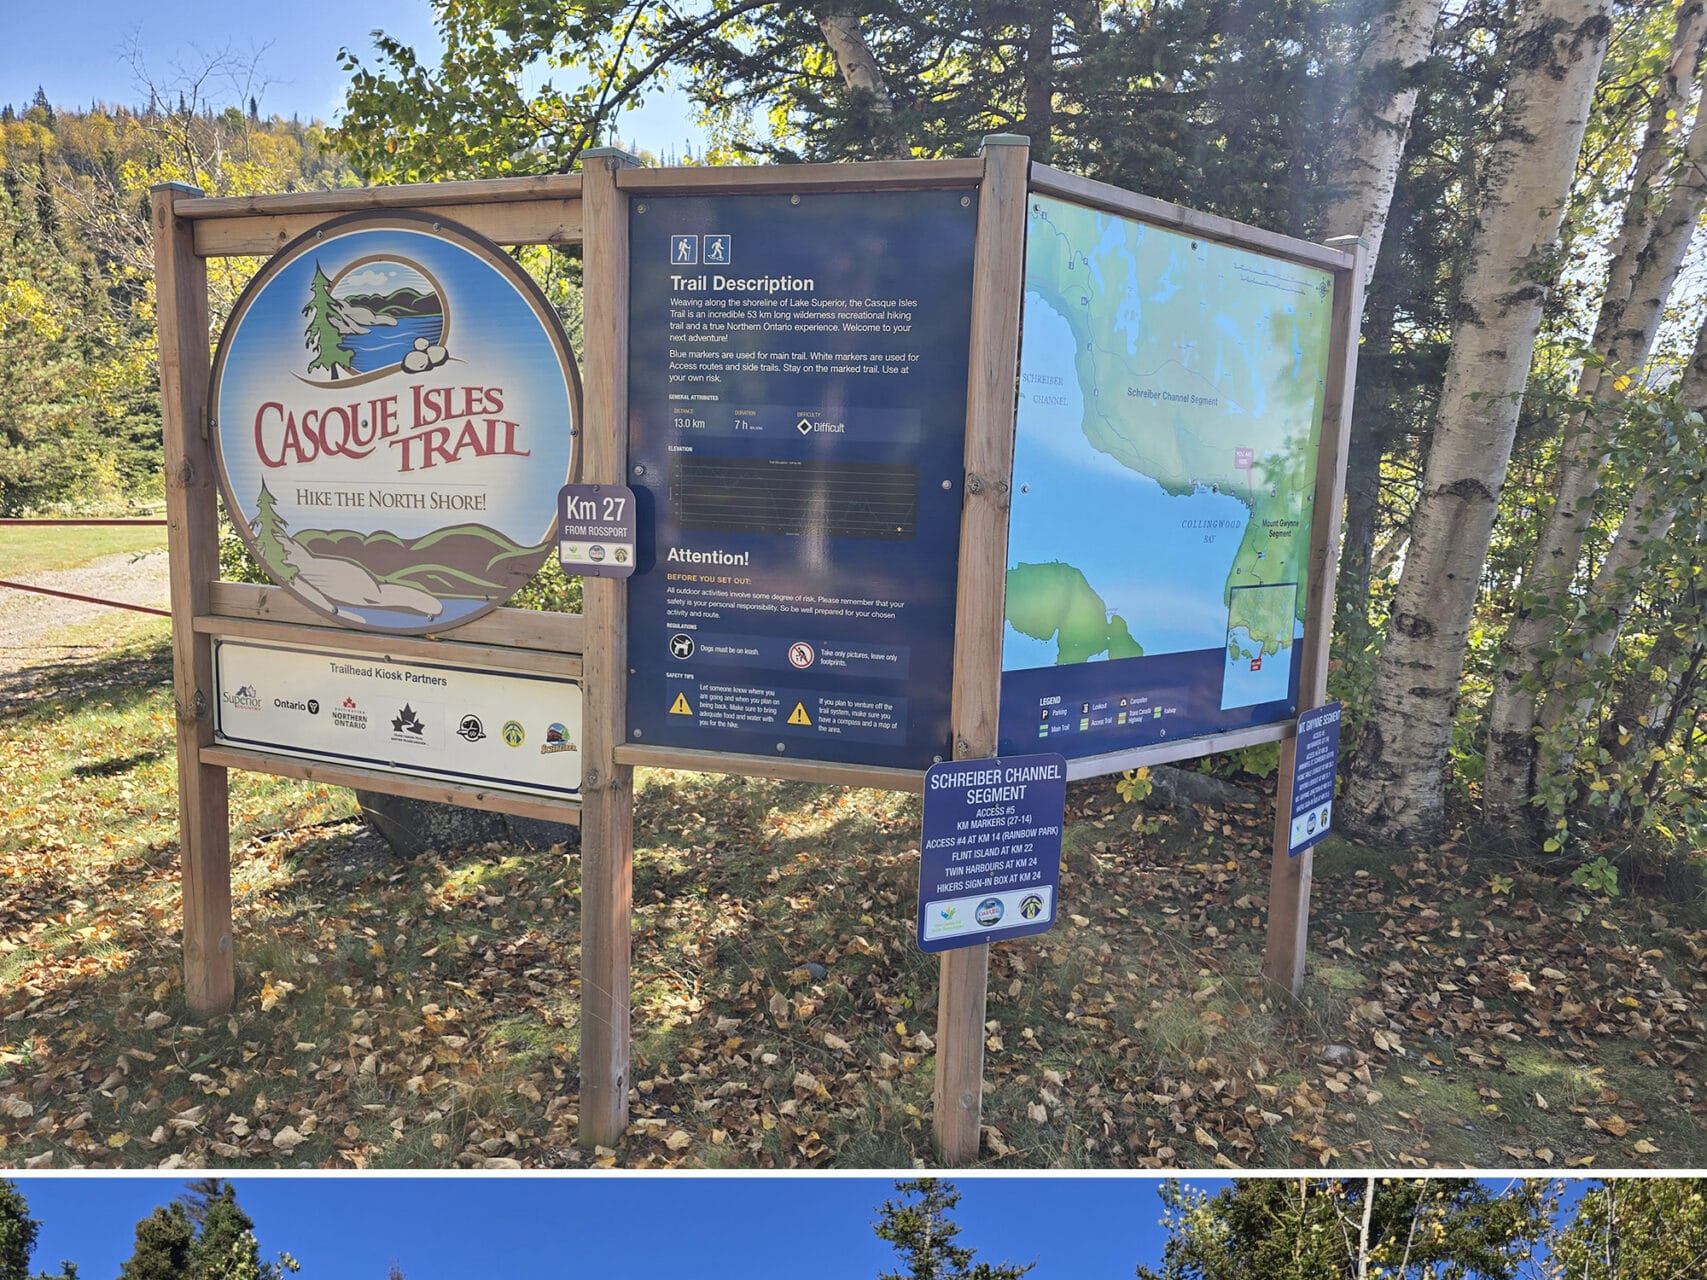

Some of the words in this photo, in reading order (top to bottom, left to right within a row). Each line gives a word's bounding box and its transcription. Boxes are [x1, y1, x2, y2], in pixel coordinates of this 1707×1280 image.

[671, 275, 706, 290] Trail
[713, 275, 814, 294] Description
[670, 298, 702, 308] Weaving
[705, 298, 726, 308] along
[728, 298, 740, 306] the
[743, 298, 777, 306] shoreline
[780, 298, 788, 307] of
[790, 299, 809, 307] Lake
[812, 298, 847, 308] Superior,
[850, 299, 862, 307] the
[865, 299, 896, 308] Casque
[899, 299, 917, 307] Isles
[670, 310, 685, 318] Trail
[688, 310, 694, 318] is
[708, 310, 745, 318] incredible
[774, 311, 791, 320] long
[793, 311, 835, 319] wilderness
[838, 311, 884, 319] recreational
[887, 311, 911, 321] hiking
[670, 322, 684, 330] trail
[686, 322, 700, 330] and
[727, 322, 761, 330] Northern
[794, 323, 840, 333] experience.
[842, 323, 880, 331] Welcome
[893, 325, 912, 334] your
[688, 334, 728, 342] adventure!
[670, 350, 687, 358] Blue
[689, 351, 720, 359] markers
[736, 351, 755, 359] used
[757, 351, 768, 359] for
[792, 352, 808, 360] trail.
[810, 352, 833, 360] White
[885, 353, 905, 361] used
[908, 353, 920, 361] for
[1033, 395, 1068, 406] CHANNEL
[1127, 387, 1160, 401] Schreiber
[1162, 391, 1188, 404] Channel
[1190, 393, 1218, 408] Segment
[255, 394, 399, 468] CASQUE
[410, 385, 504, 429] ISLES
[674, 418, 690, 428] 13.0
[692, 419, 705, 428] km
[735, 420, 740, 429] 7
[742, 420, 748, 430] h
[814, 423, 845, 432] Difficult
[389, 418, 531, 473] TRAIL
[296, 488, 333, 508] HIKE
[334, 491, 366, 508] THE
[368, 490, 426, 510] NORTH
[430, 492, 486, 512] SHORE!
[567, 496, 596, 520] Km
[603, 497, 626, 521] 27
[1182, 520, 1241, 529] COLLINGWOOD
[1262, 519, 1279, 527] Mount
[1280, 520, 1299, 528] Gwynne
[565, 526, 586, 535] FROM
[588, 526, 628, 537] ROSSPORT
[1269, 530, 1291, 539] Segment
[667, 548, 749, 566] Attention!
[667, 574, 697, 582] BEFORE
[700, 575, 715, 583] YOU
[330, 663, 372, 678] Trailhead
[375, 668, 402, 682] Kiosk
[405, 671, 448, 687] Partners
[223, 691, 262, 708] Superior
[274, 699, 306, 711] Ontario
[1040, 696, 1061, 706] LEGEND
[332, 712, 367, 722] NORTHERN
[334, 720, 366, 730] ONTARIO
[931, 771, 1001, 790] SCHREIBER
[1005, 765, 1061, 783] CHANNEL
[967, 785, 1027, 804] SEGMENT
[976, 806, 1005, 818] ACCESS
[1006, 806, 1015, 815] #5
[957, 820, 969, 830] KM
[971, 817, 1005, 829] MARKERS
[1007, 815, 1032, 827] (27-14)
[926, 837, 955, 849] ACCESS
[957, 836, 966, 846] #4
[968, 835, 976, 845] AT
[978, 833, 990, 843] KM
[992, 832, 1000, 842] 14
[1002, 828, 1037, 842] (RAINBOW
[1038, 826, 1058, 837] PARK)
[952, 850, 972, 861] FLINT
[974, 847, 999, 858] ISLAND
[1000, 845, 1010, 855] AT
[1011, 844, 1022, 854] KM
[1024, 843, 1033, 852] 22
[945, 866, 964, 877] TWIN
[965, 862, 1004, 875] HARBOURS
[1005, 860, 1014, 869] AT
[1016, 858, 1027, 868] KM
[1028, 857, 1037, 866] 24
[936, 881, 963, 893] HIKERS
[965, 878, 992, 890] SIGN-IN
[994, 876, 1008, 886] BOX
[1009, 874, 1018, 884] AT
[1019, 872, 1031, 882] KM
[1032, 871, 1041, 880] 24
